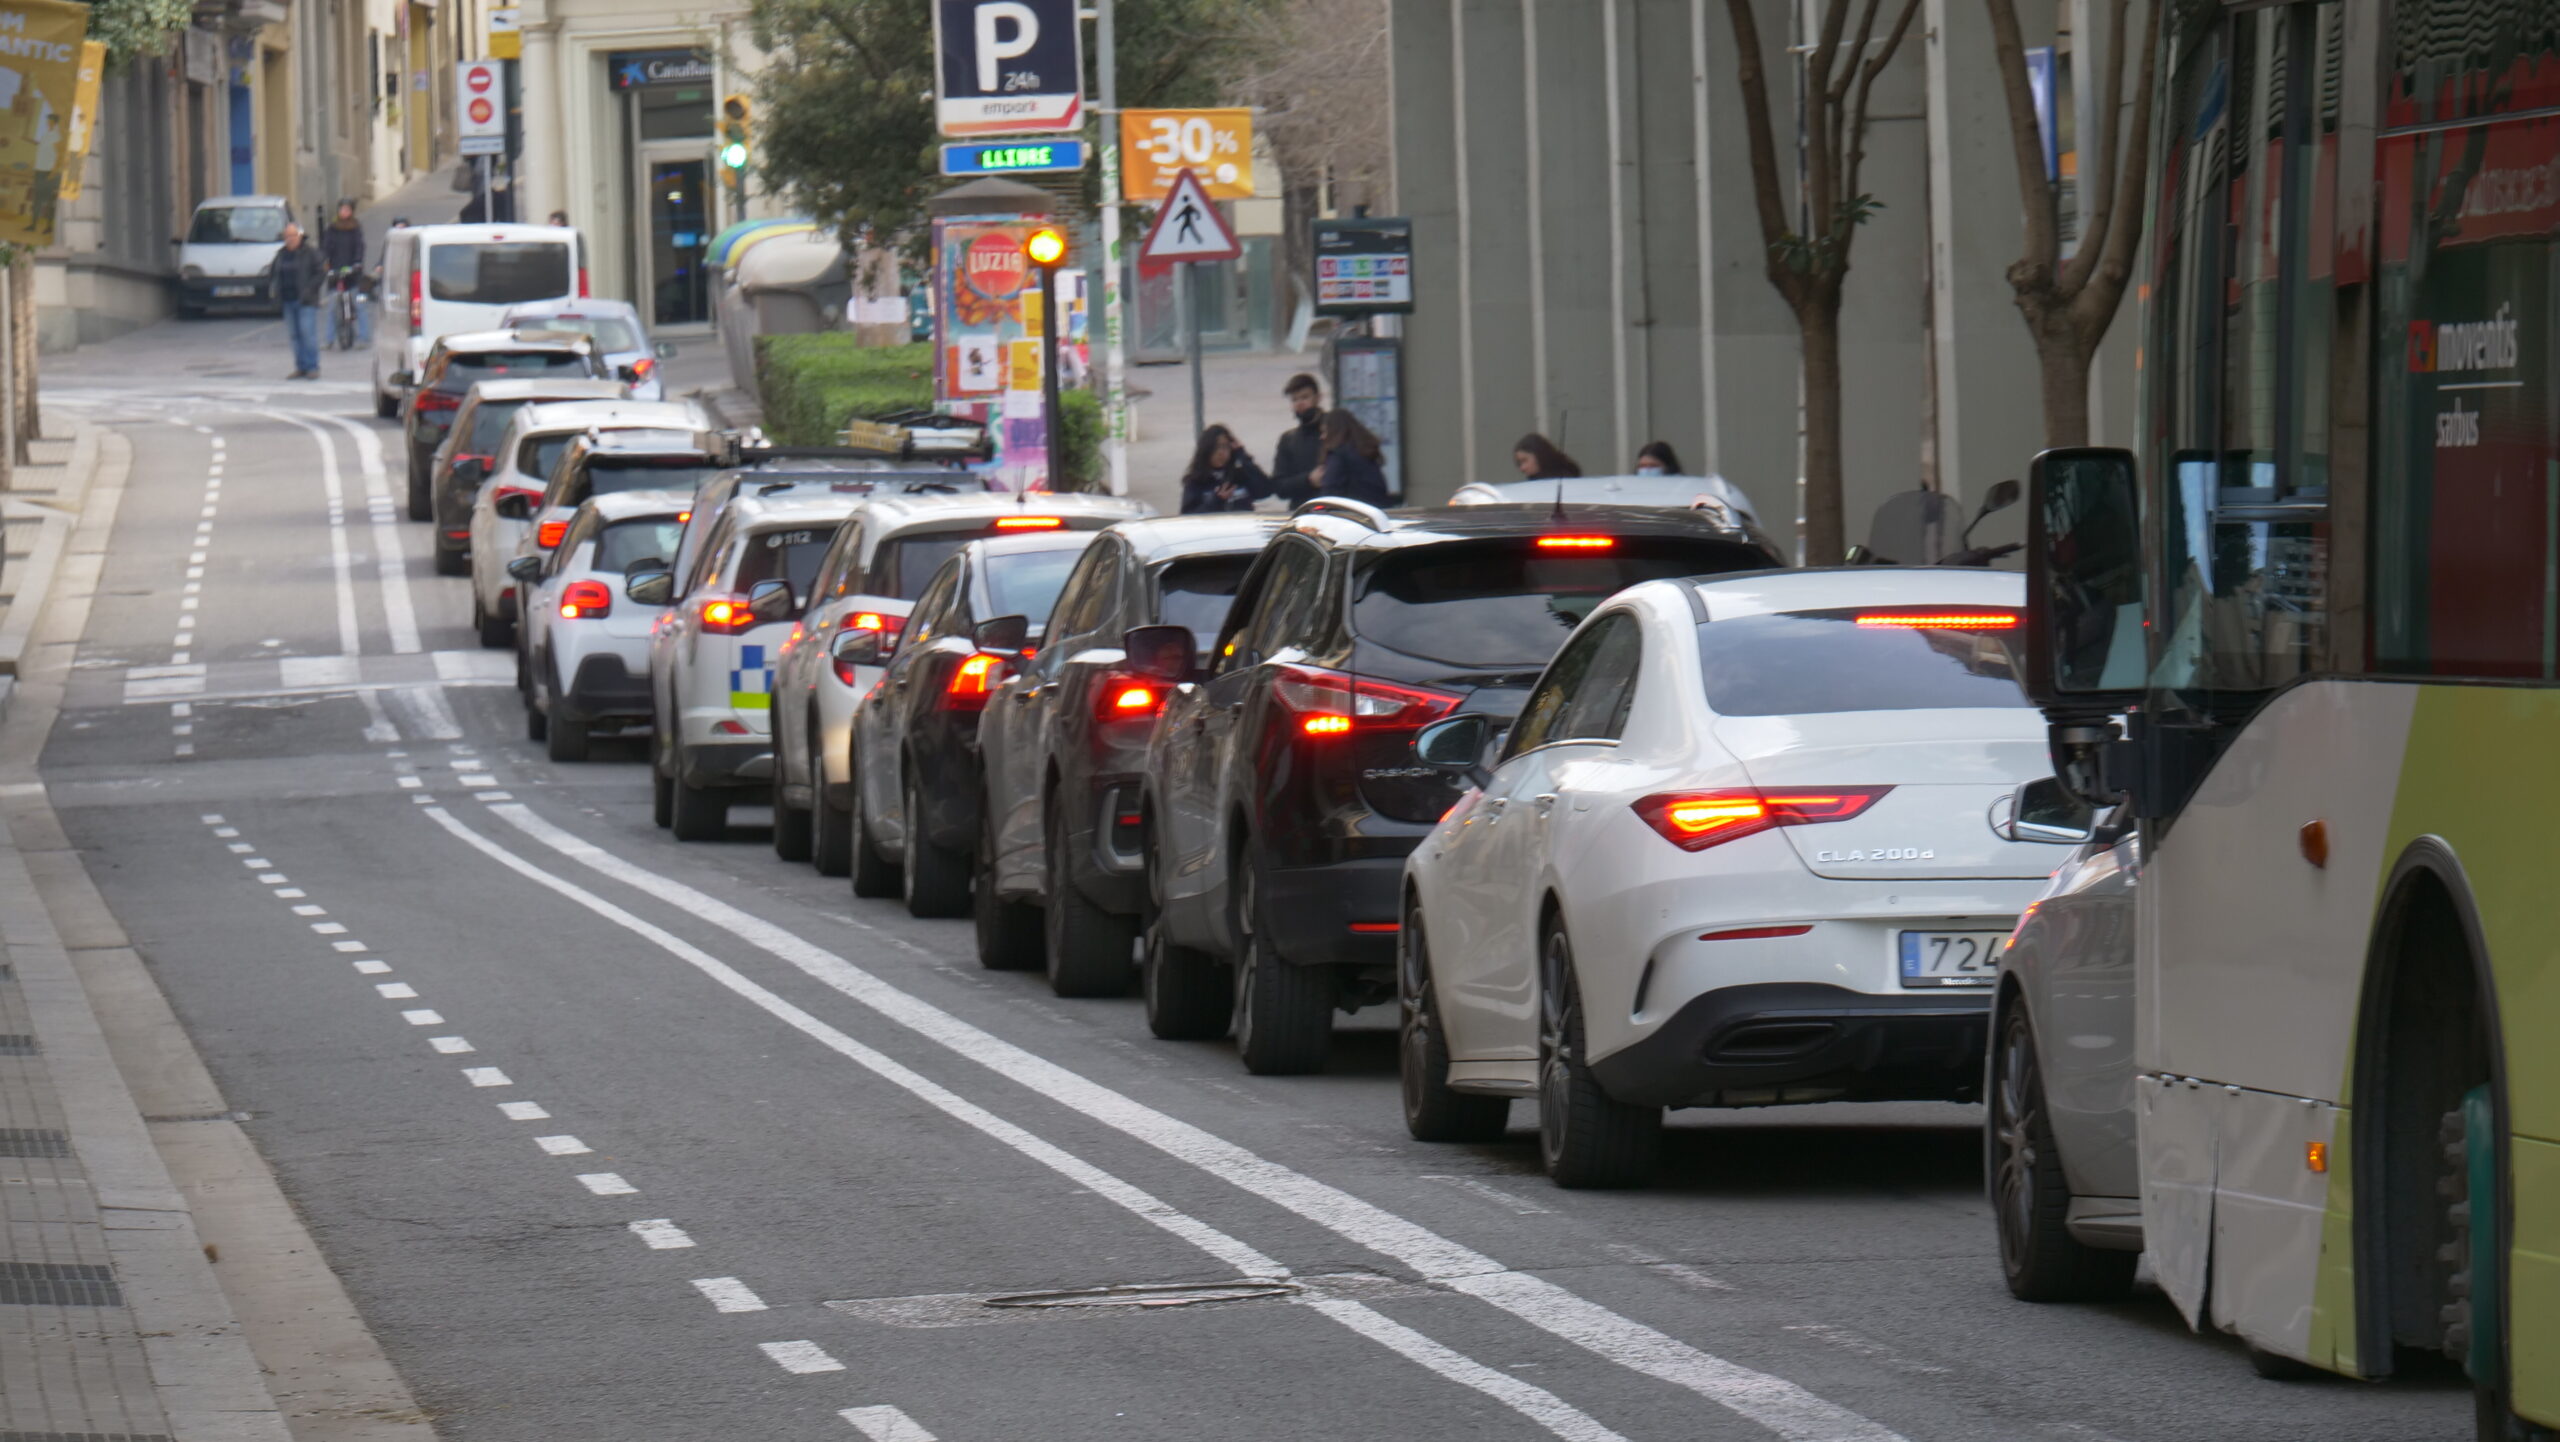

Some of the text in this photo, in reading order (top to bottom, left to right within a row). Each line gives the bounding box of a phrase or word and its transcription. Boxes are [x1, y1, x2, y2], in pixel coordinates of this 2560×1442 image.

[974, 1, 1040, 92] P
[1004, 71, 1040, 91] 24h
[2437, 301, 2517, 371] moventis
[2436, 397, 2479, 447] sarbus
[1817, 848, 1934, 863] CLA 200d
